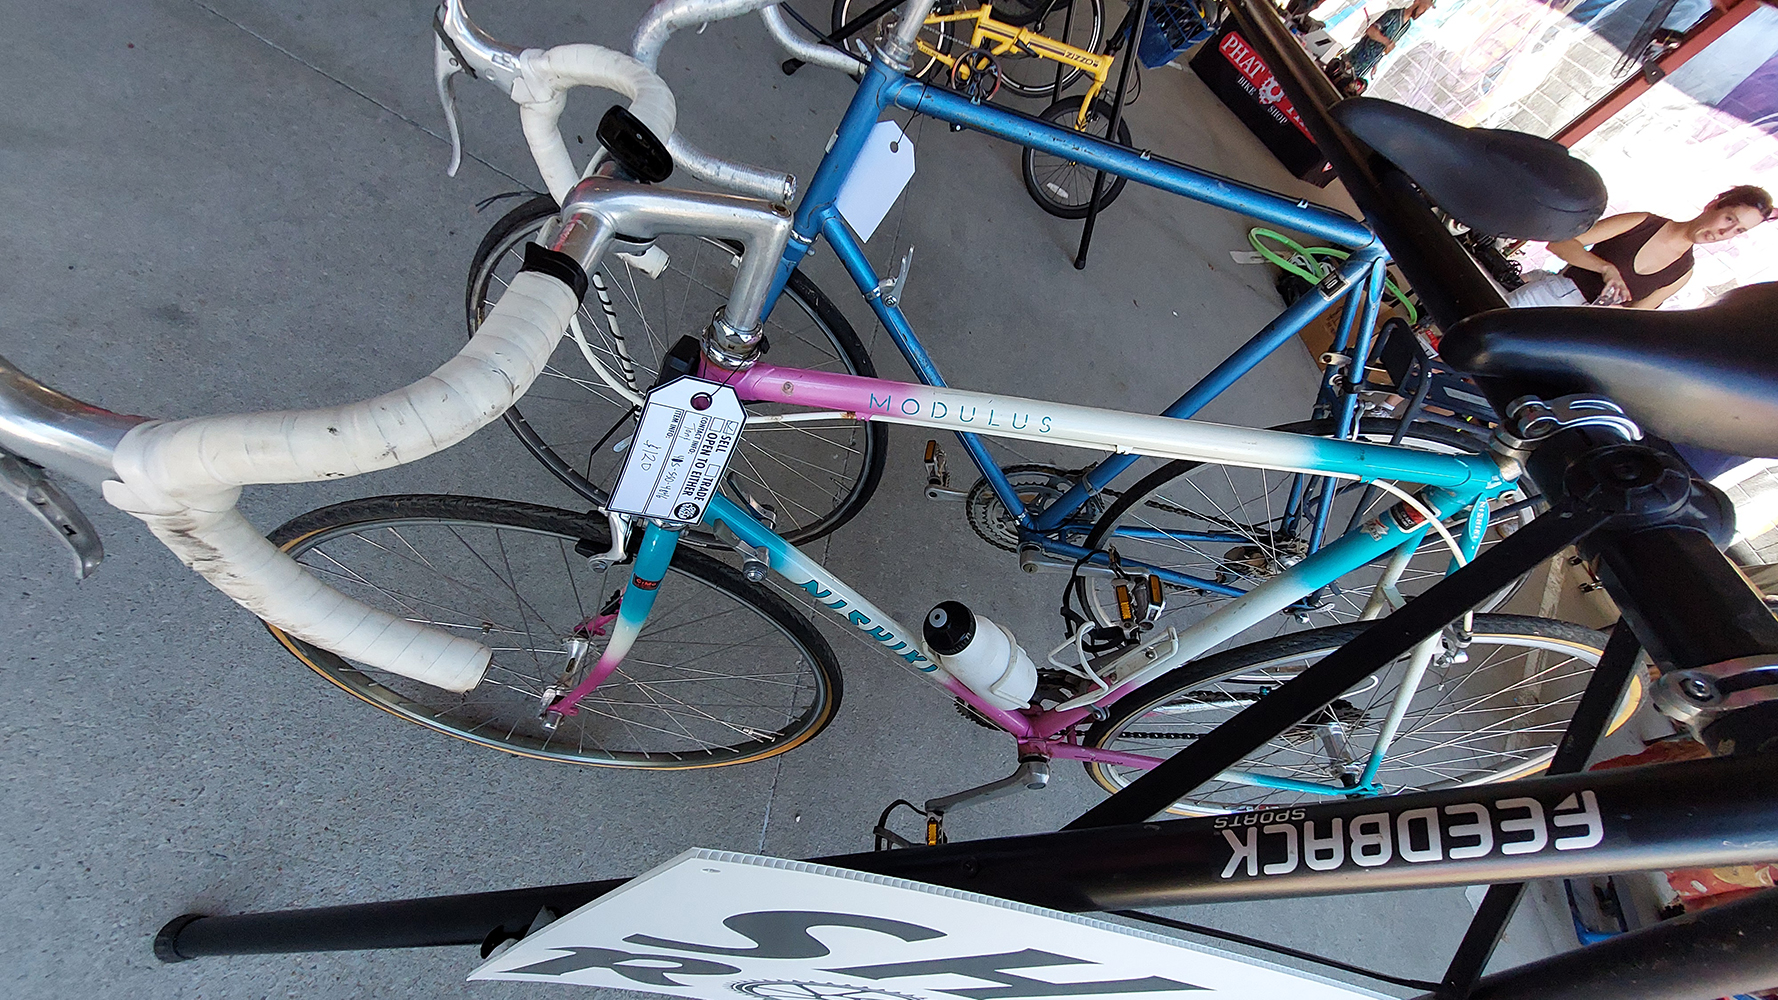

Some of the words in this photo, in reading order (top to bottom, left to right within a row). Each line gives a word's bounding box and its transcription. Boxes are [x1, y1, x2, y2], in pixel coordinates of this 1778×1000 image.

[1222, 35, 1265, 79] PHAT
[1237, 75, 1257, 96] BIKE
[1267, 105, 1288, 124] SHOP
[671, 410, 682, 423] ITEM
[869, 393, 1052, 434] MODULUS
[665, 424, 677, 439] INFO:
[694, 416, 708, 440] CONTACT
[688, 440, 699, 455] INFO:
[700, 432, 718, 456] OPEN
[715, 435, 732, 453] SELL
[695, 458, 708, 469] TO
[682, 470, 702, 496] EITHER
[694, 477, 714, 501] TRADE
[799, 579, 939, 673] NISHIKI
[1214, 808, 1306, 828] SPORTS
[1221, 790, 1604, 879] FEEDBACK
